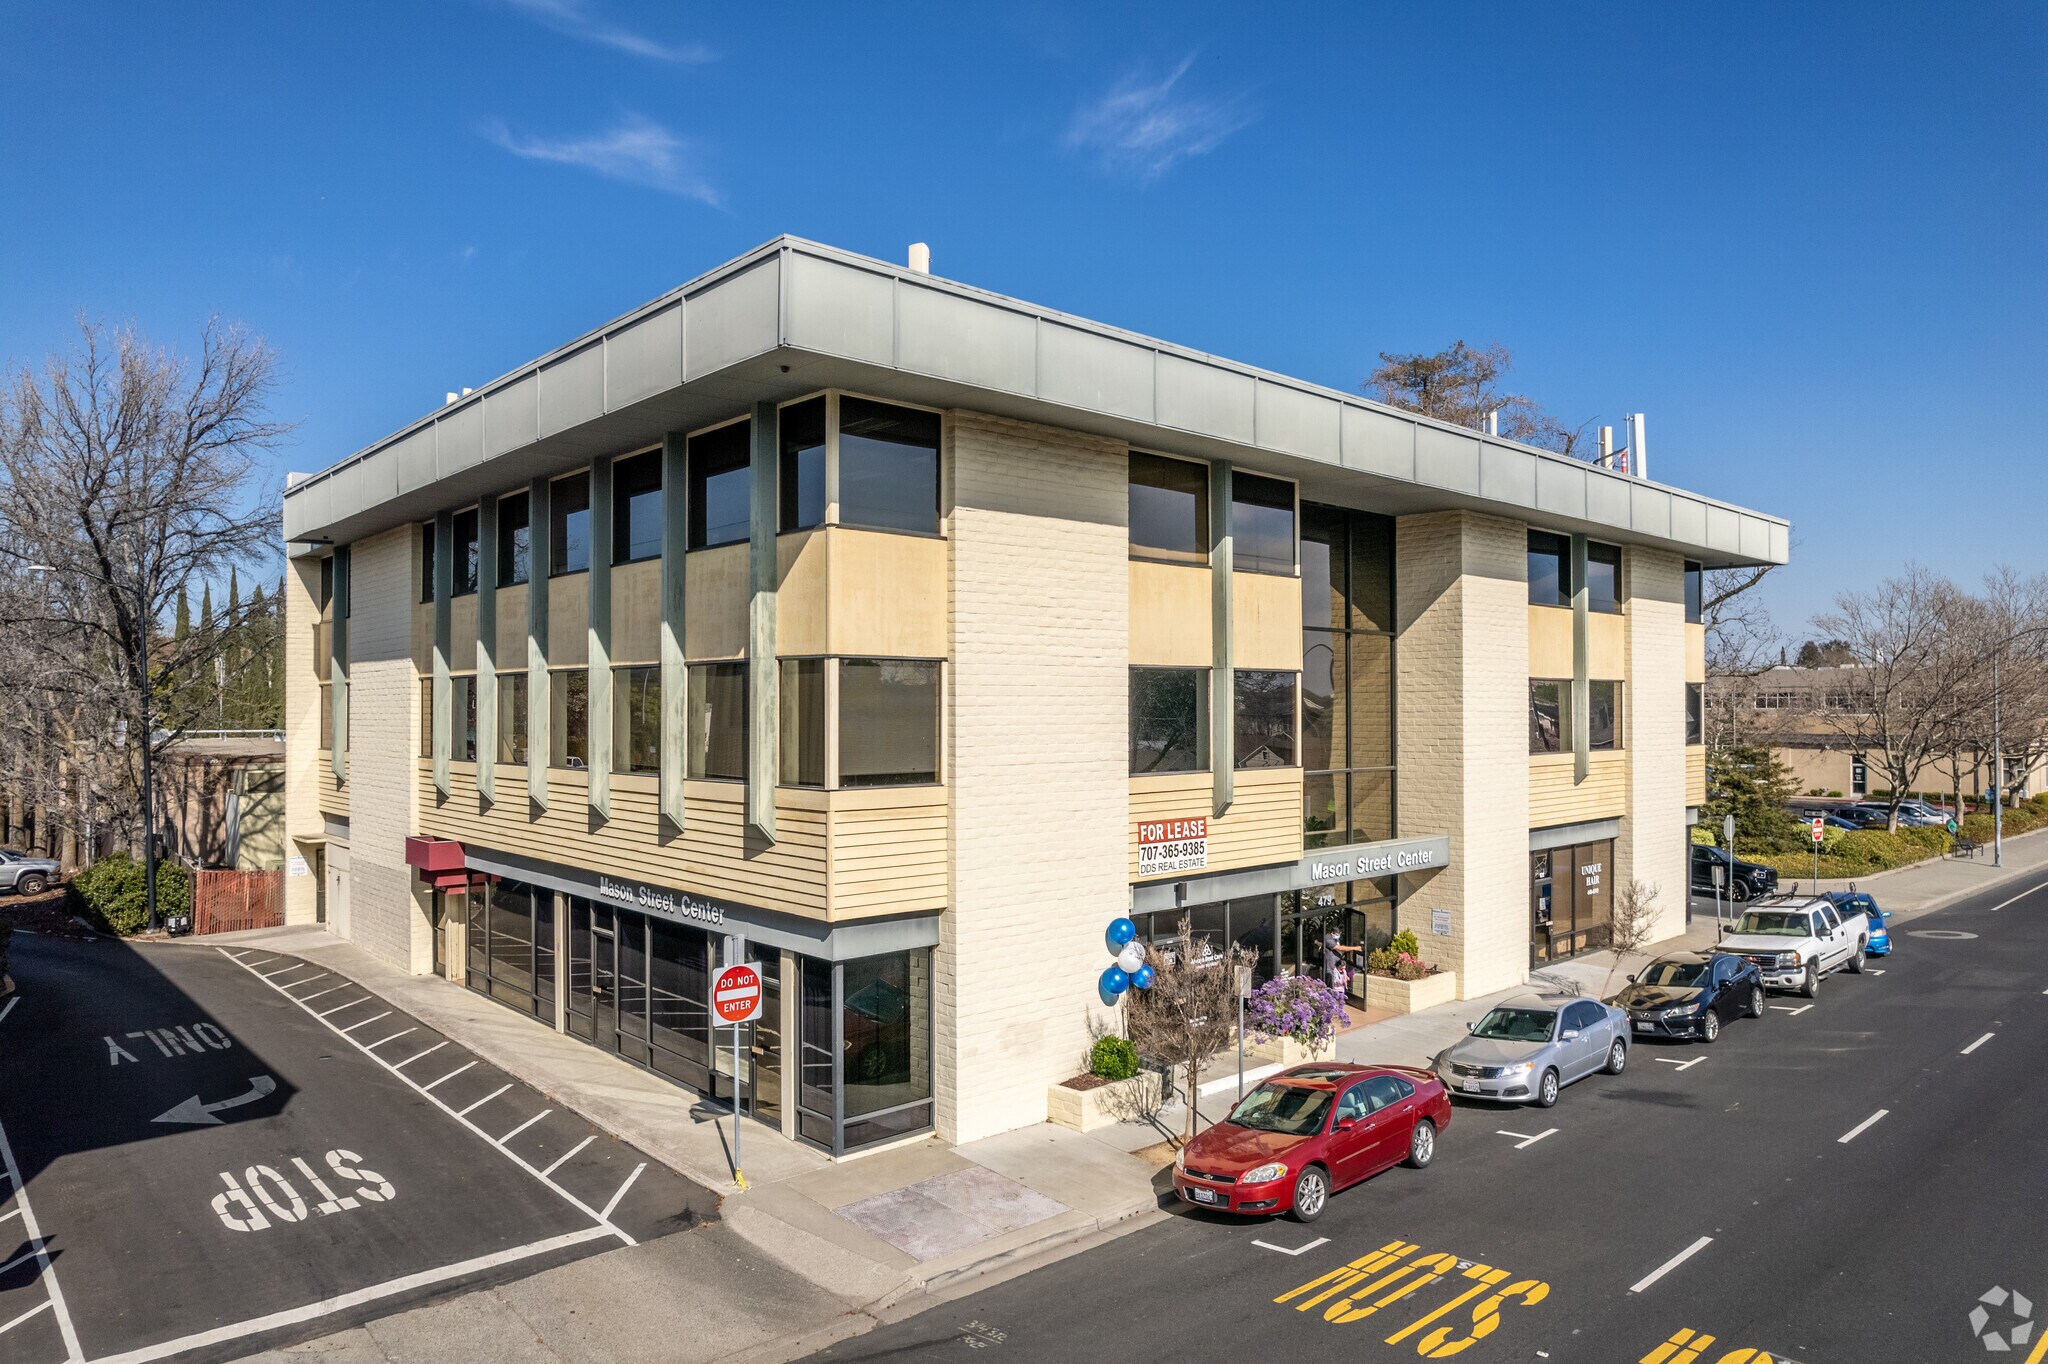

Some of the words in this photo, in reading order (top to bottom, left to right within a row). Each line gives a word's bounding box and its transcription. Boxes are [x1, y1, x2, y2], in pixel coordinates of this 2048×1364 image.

[1140, 823, 1165, 842] FOR
[1167, 820, 1205, 840] LEASE
[1140, 841, 1205, 862] 707-365-9385
[1140, 863, 1157, 875] DDS
[1158, 861, 1177, 872] REAL
[1178, 857, 1205, 870] ESTATE
[1311, 862, 1350, 881] Mason
[1357, 854, 1392, 875] Street
[1397, 850, 1433, 868] Center
[1581, 863, 1602, 876] UNIQUE
[1586, 875, 1600, 886] HAIR
[600, 876, 634, 903] Mason
[639, 886, 675, 913] Street
[681, 895, 725, 925] Center
[1317, 894, 1333, 907] 479
[721, 978, 734, 988] DO
[737, 974, 755, 986] NOT
[724, 1000, 751, 1013] ENTER
[103, 1022, 232, 1066] ONLY
[211, 1149, 396, 1231] STOP
[1273, 1240, 1550, 1358] SLOW
